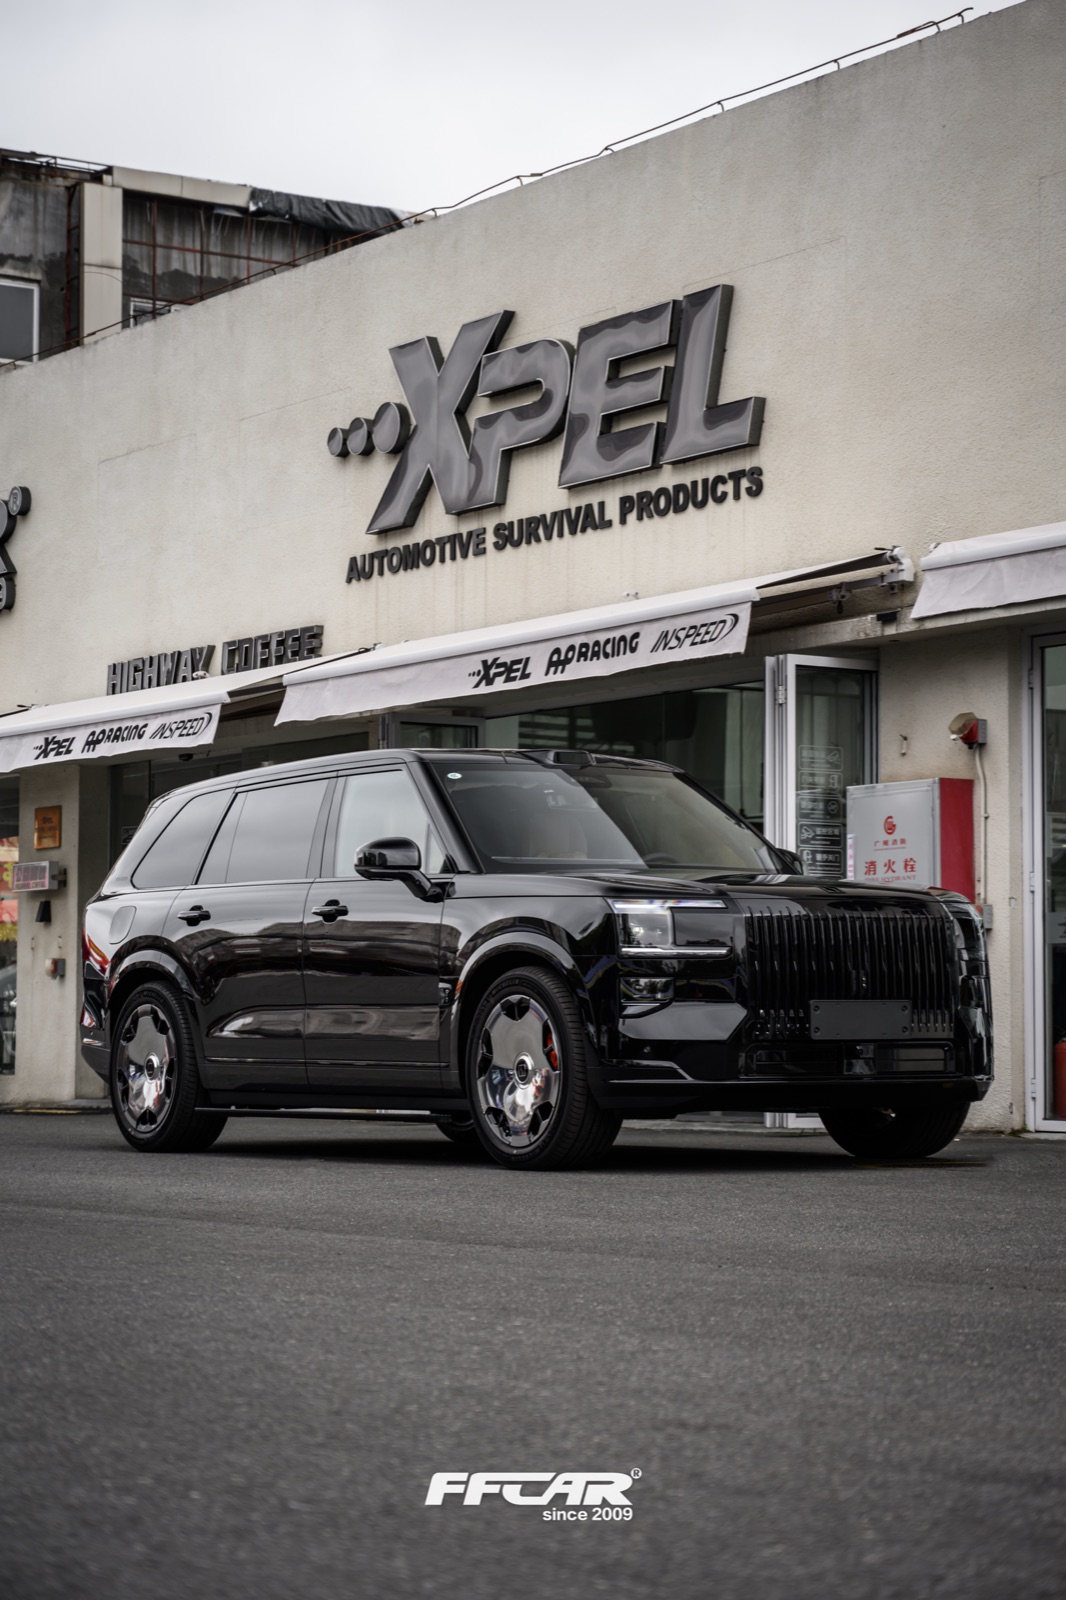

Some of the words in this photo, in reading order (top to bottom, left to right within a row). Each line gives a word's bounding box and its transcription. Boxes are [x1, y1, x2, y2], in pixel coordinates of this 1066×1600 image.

[366, 284, 766, 535] XPEL
[345, 527, 486, 583] AUTOMOTIVE
[493, 500, 612, 551] SURVIVAL
[619, 466, 764, 525] PRODUCTS
[107, 644, 216, 696] HIGHWAY
[221, 625, 324, 676] COFFEE
[472, 656, 531, 689] XPEL
[650, 619, 730, 653] INSPEED
[34, 736, 76, 760] XPEL
[150, 716, 205, 740] INSPEED
[864, 857, 917, 876] 消火栓
